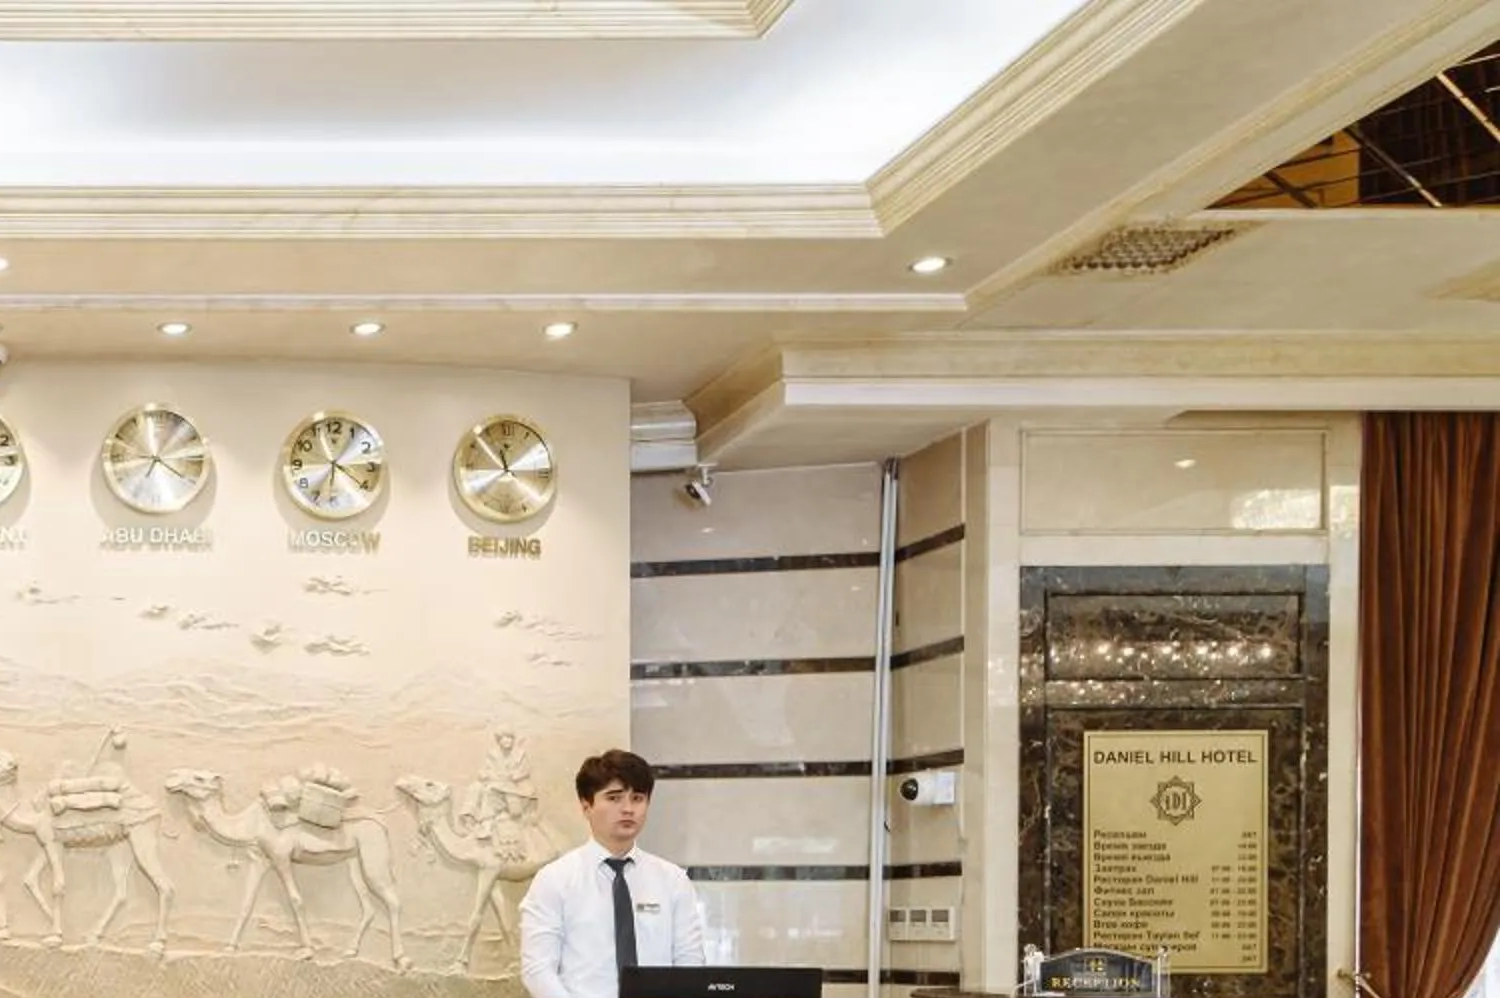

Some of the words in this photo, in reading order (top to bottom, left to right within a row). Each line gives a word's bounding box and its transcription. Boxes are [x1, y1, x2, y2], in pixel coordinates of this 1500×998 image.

[326, 421, 342, 434] 12
[296, 439, 313, 453] 10
[361, 441, 371, 454] 2
[292, 459, 303, 470] 9
[299, 477, 308, 489] 8
[288, 529, 380, 549] MOSCOW
[468, 537, 540, 556] BEIJING
[1094, 751, 1154, 765] DANIEL
[1160, 751, 1196, 764] HILL
[1201, 751, 1258, 764] HOTEL
[1094, 875, 1143, 884] Ресторан
[1145, 874, 1179, 883] Daniel
[1182, 875, 1199, 883] Hill
[1094, 931, 1143, 940] Ресторан
[1051, 976, 1141, 989] RECEPTION
